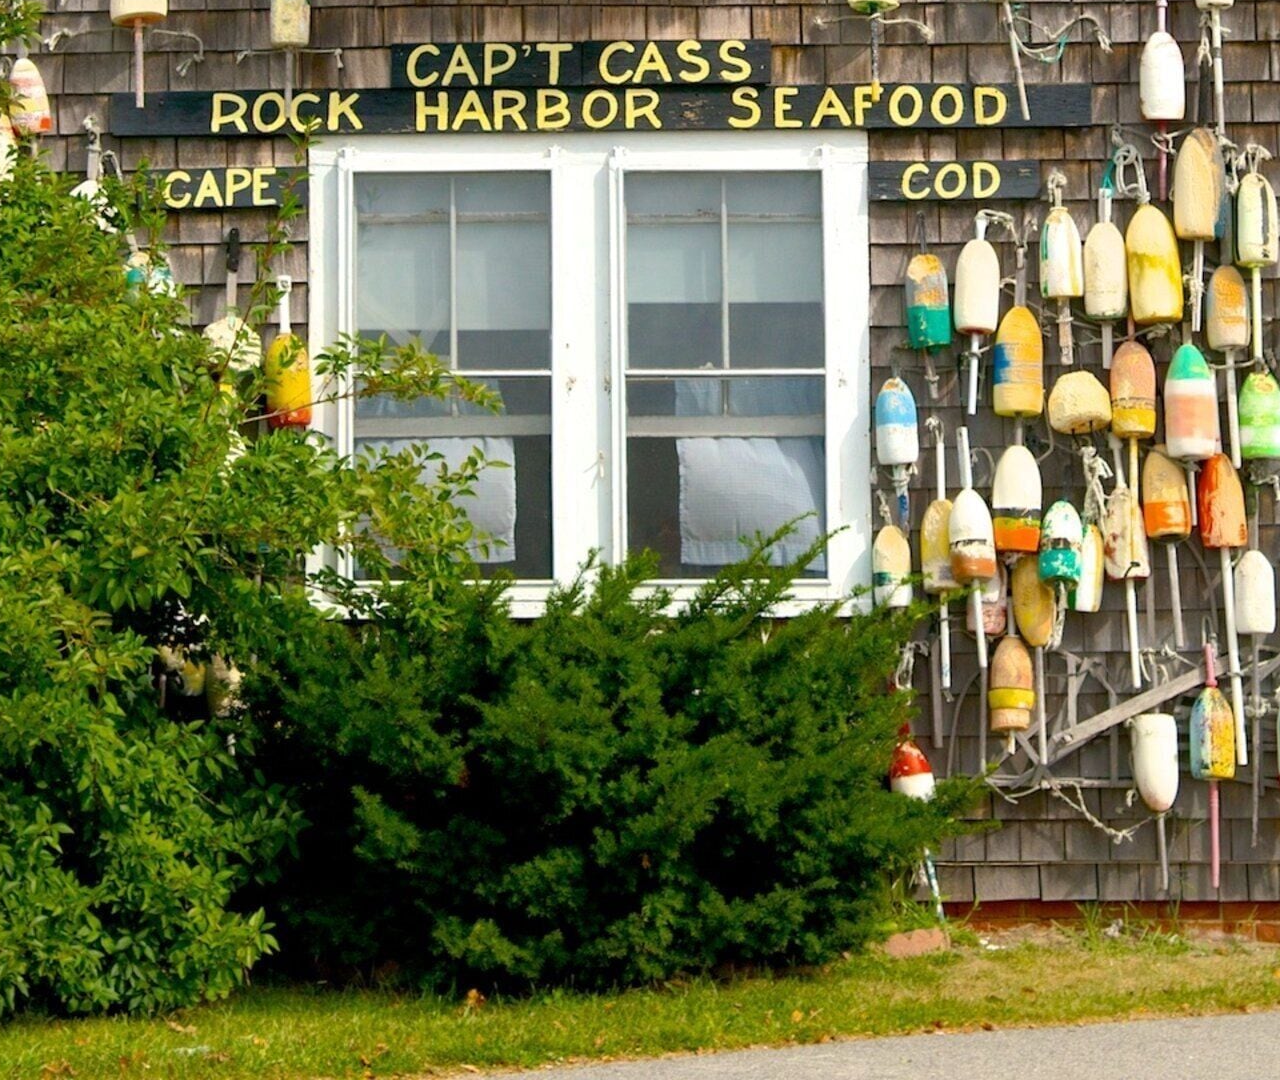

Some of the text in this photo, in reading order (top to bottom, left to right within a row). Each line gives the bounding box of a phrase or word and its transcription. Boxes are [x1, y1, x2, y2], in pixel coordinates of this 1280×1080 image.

[406, 37, 753, 87] CAP'T CASS
[210, 84, 1008, 133] ROCK HARBOR SEAFOOD
[162, 166, 278, 209] CAPE
[901, 161, 1002, 200] COD
